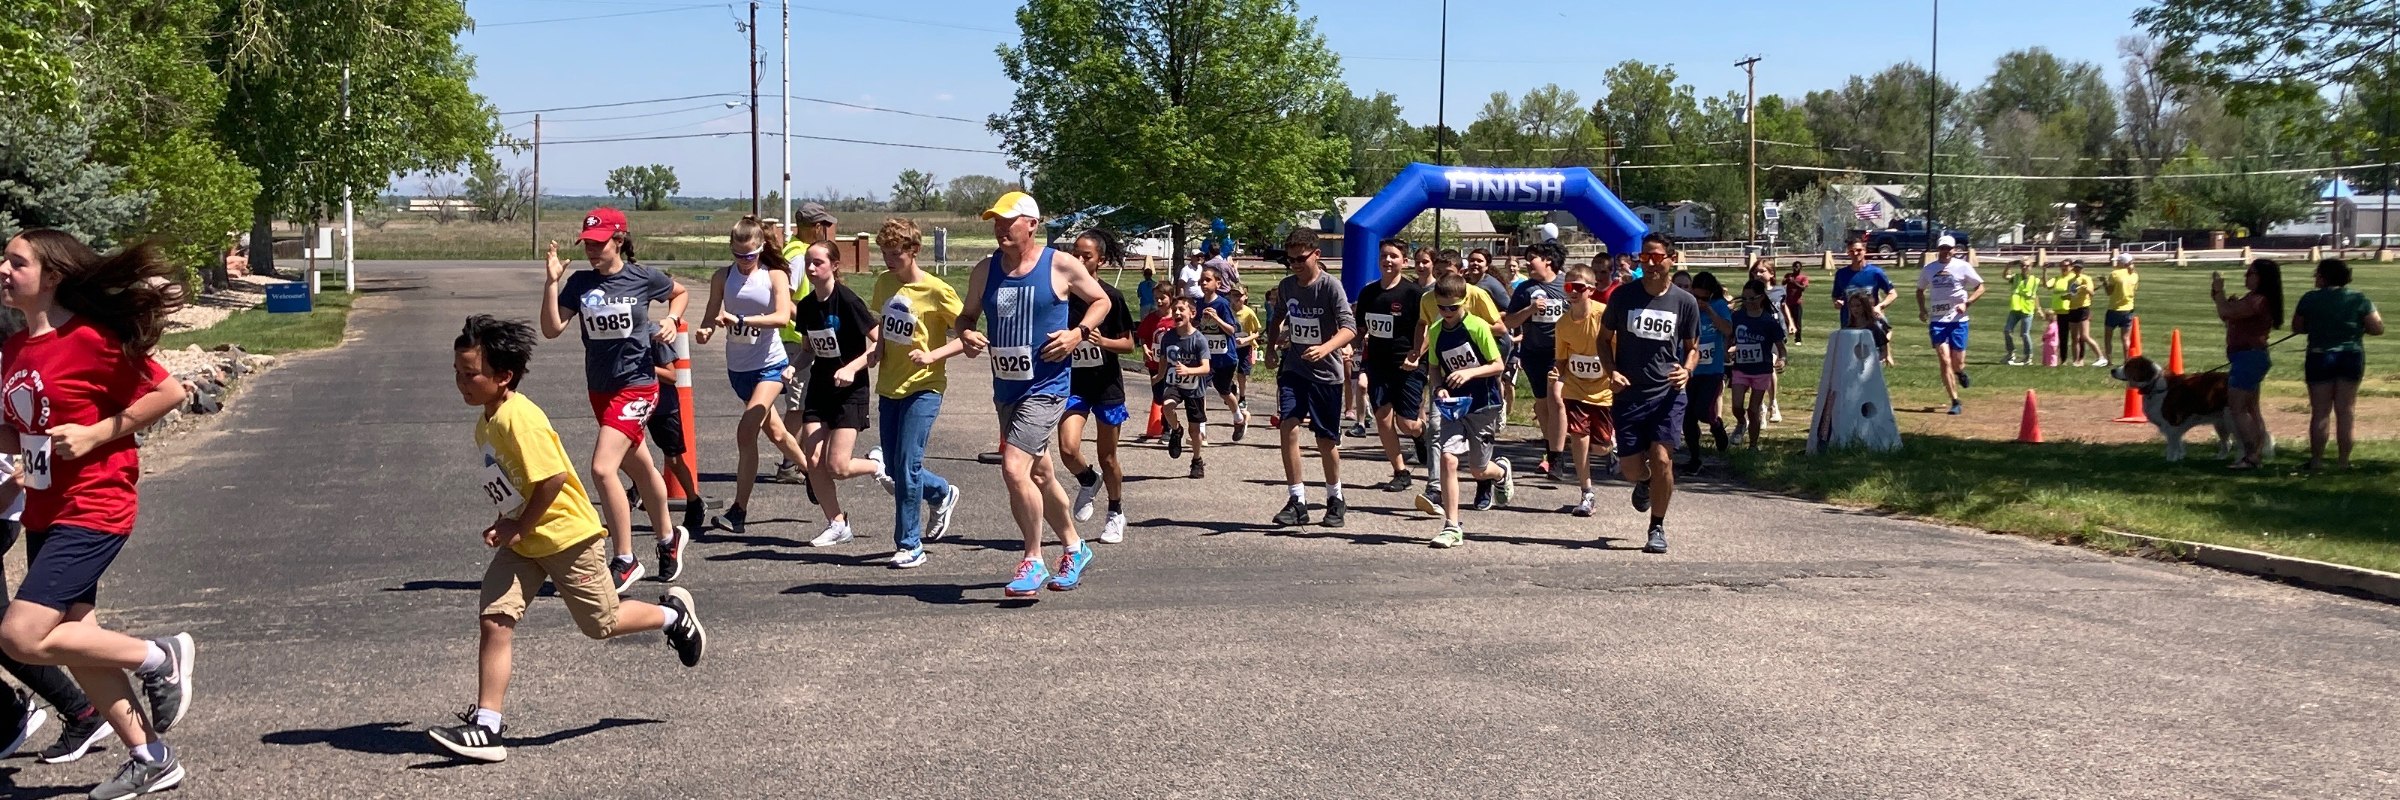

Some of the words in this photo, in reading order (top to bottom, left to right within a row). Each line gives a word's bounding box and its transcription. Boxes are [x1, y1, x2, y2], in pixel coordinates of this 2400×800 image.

[1444, 171, 1566, 203] FINISH
[271, 292, 306, 300] Welcome!
[1535, 305, 1561, 316] 958
[586, 312, 631, 332] 1985
[729, 323, 761, 337] 1978
[881, 314, 914, 337] 1909
[1367, 319, 1392, 333] 1970
[1634, 315, 1673, 334] 1966
[1289, 322, 1320, 339] 1975
[1072, 345, 1101, 361] 910
[1446, 350, 1477, 372] 1984
[1736, 348, 1761, 360] 1917
[992, 354, 1031, 372] 1926
[1570, 360, 1601, 374] 1979
